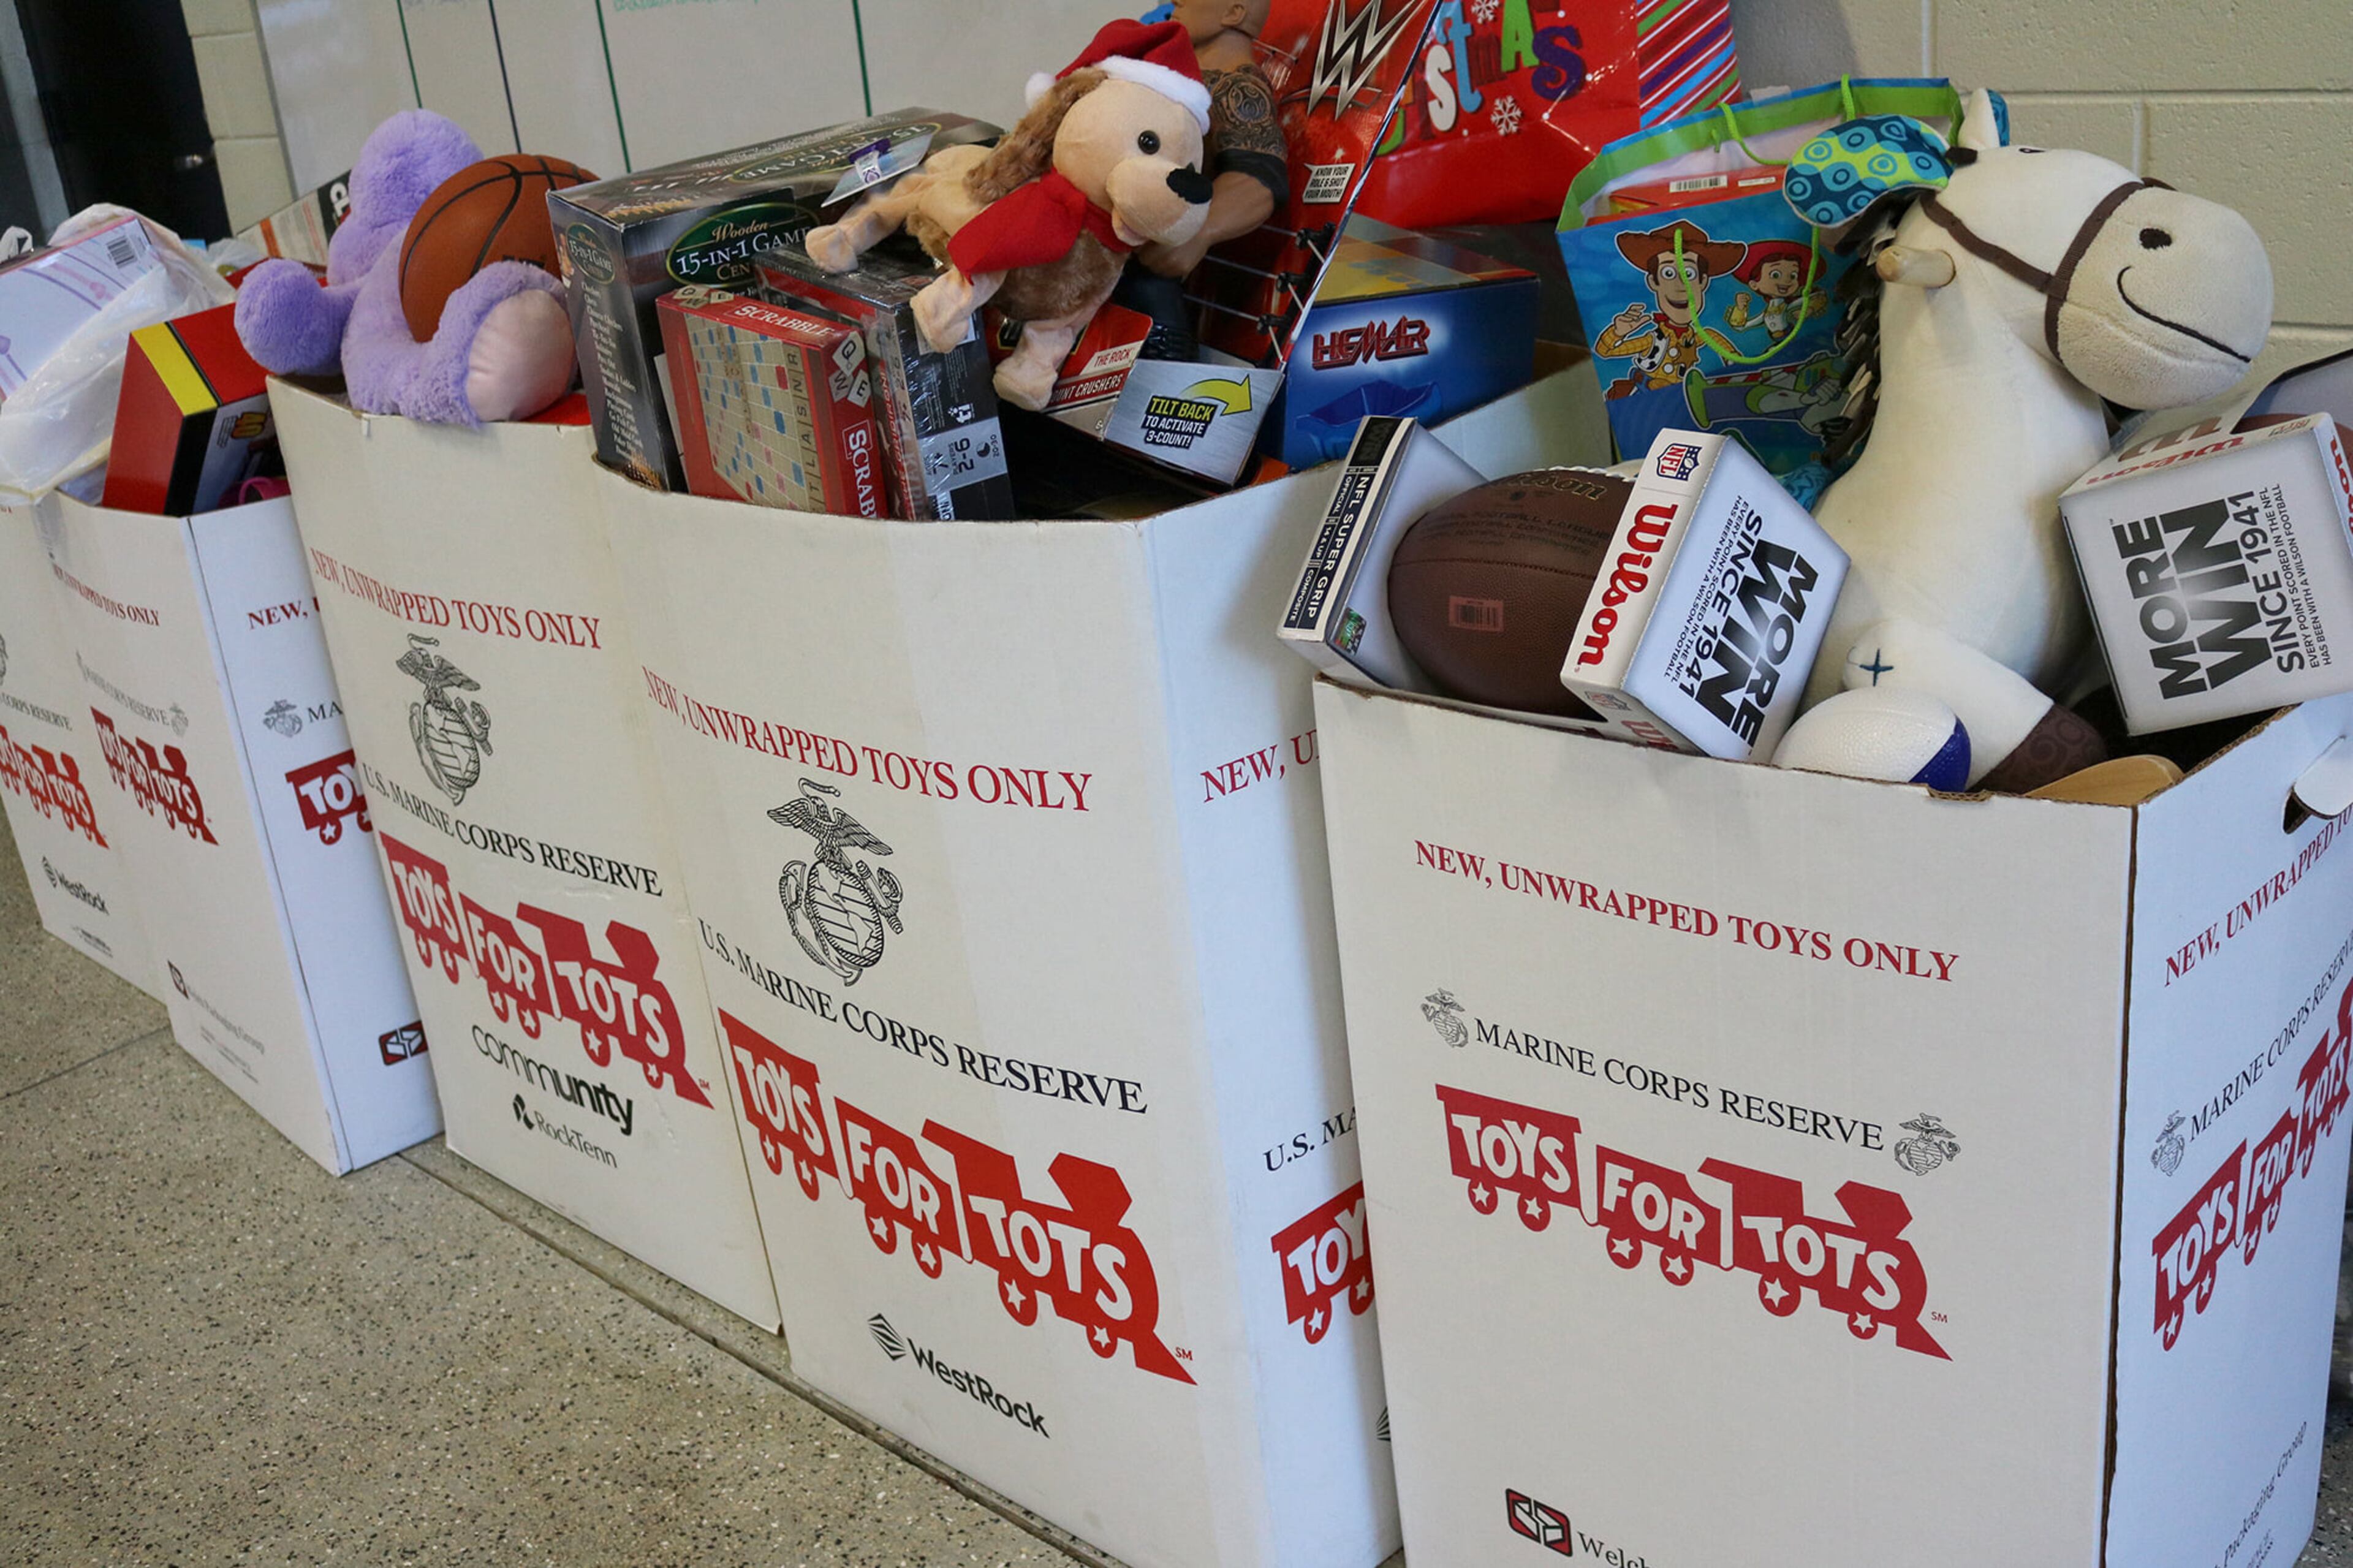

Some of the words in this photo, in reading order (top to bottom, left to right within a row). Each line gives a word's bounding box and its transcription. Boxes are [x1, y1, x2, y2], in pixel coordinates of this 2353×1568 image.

[1328, 177, 1346, 186] SHUT
[1333, 165, 1349, 175] YOUR
[1305, 189, 1320, 199] YOUR
[712, 219, 769, 243] Wooden
[676, 240, 750, 275] 15-IN-1
[735, 305, 834, 336] SCRABBLE
[1094, 352, 1110, 367] THE
[1110, 349, 1132, 363] ROCK
[1051, 386, 1076, 403] OUNT
[1075, 374, 1124, 398] CRUSHERS
[1149, 398, 1180, 414] TILT
[1180, 404, 1214, 421] BACK
[991, 434, 999, 458] 20-30
[1145, 415, 1159, 427] TO
[1160, 419, 1205, 435] ACTIVATE
[1146, 431, 1192, 447] 3-COUNT!
[848, 429, 877, 518] SCRAB
[954, 437, 974, 472] 2-6
[1660, 447, 1686, 475] NFL
[1332, 477, 1352, 515] OFFICIAL
[1349, 476, 1367, 509] NFL
[1730, 496, 1743, 518] HAS
[2259, 487, 2273, 509] NFL
[2272, 483, 2296, 537] FOOTBALL
[1718, 519, 1733, 547] BEEN
[1734, 501, 1749, 540] EVERY
[2228, 491, 2273, 563] 1941
[2266, 510, 2280, 532] THE
[1322, 513, 1354, 572] SUPER
[1707, 545, 1722, 577] WITH
[1711, 509, 1762, 618] SINCE
[1718, 539, 1733, 575] POINT
[2290, 539, 2307, 578] WILSON
[1578, 503, 1678, 665] Wilson
[2160, 498, 2272, 689] WIN
[2280, 550, 2298, 595] SCORED
[127, 605, 159, 626] ONLY
[248, 602, 308, 630] NEW,
[311, 547, 346, 593] NEW,
[344, 564, 450, 626] UNWRAPPED
[452, 599, 521, 638] TOYS
[525, 608, 602, 650] ONLY
[1289, 569, 1314, 621] COMPOSITE
[1308, 577, 1329, 619] GRIP
[1687, 585, 1706, 624] WILSON
[1697, 574, 1719, 621] SCORED
[2113, 515, 2208, 700] MORE
[2294, 599, 2310, 631] POINT
[2304, 589, 2317, 615] WITH
[1696, 540, 1795, 726] WIN
[2253, 572, 2305, 674] SINCE
[2311, 616, 2326, 643] BEEN
[1664, 624, 1691, 681] FOOTBALL
[1678, 626, 1719, 698] 1941
[1681, 638, 1694, 661] THE
[1732, 555, 1818, 747] MORE
[2303, 635, 2319, 668] EVERY
[2319, 645, 2332, 665] HAS
[1671, 661, 1684, 683] NFL
[642, 665, 687, 725] NEW,
[683, 694, 858, 777] UNWRAPPED
[861, 744, 959, 800] TOYS
[968, 763, 1093, 812] ONLY
[151, 768, 199, 819] TOTS
[1200, 743, 1286, 805] NEW,
[362, 762, 390, 799] U.S.
[391, 780, 455, 836] MARINE
[454, 819, 534, 863] CORPS
[537, 842, 662, 897] RESERVE
[1414, 839, 1493, 888] NEW,
[1497, 861, 1719, 938] UNWRAPPED
[1727, 914, 1832, 962] TOYS
[1843, 937, 1960, 983] ONLY
[2164, 923, 2221, 988] NEW,
[2226, 819, 2333, 940] UNWRAPPED
[392, 860, 460, 945] TOYS
[467, 911, 538, 1000] FOR
[555, 959, 670, 1059] TOTS
[698, 919, 737, 969] U.S.
[736, 944, 838, 1025] MARINE
[842, 1001, 950, 1070] CORPS
[953, 1042, 1148, 1116] RESERVE
[472, 1025, 633, 1137] community
[1474, 1017, 1597, 1078] MARINE
[1602, 1057, 1710, 1109] CORPS
[1718, 1088, 1885, 1154] RESERVE
[2189, 1053, 2265, 1143] MARINE
[2266, 1005, 2311, 1067] CORPS
[534, 1111, 618, 1168] RockTenn
[1262, 1132, 1316, 1174] U.S.
[735, 1045, 825, 1158] TOYS
[846, 1119, 942, 1235] FOR
[968, 1194, 1134, 1322] TOTS
[2161, 1180, 2235, 1299] TOYS
[2248, 1130, 2289, 1213] FOR
[2304, 1051, 2346, 1126] TOTS
[1451, 1113, 1573, 1195] TOYS
[1602, 1160, 1707, 1252] FOR
[1741, 1214, 1903, 1312] TOTS
[906, 1340, 1052, 1439] WestRock
